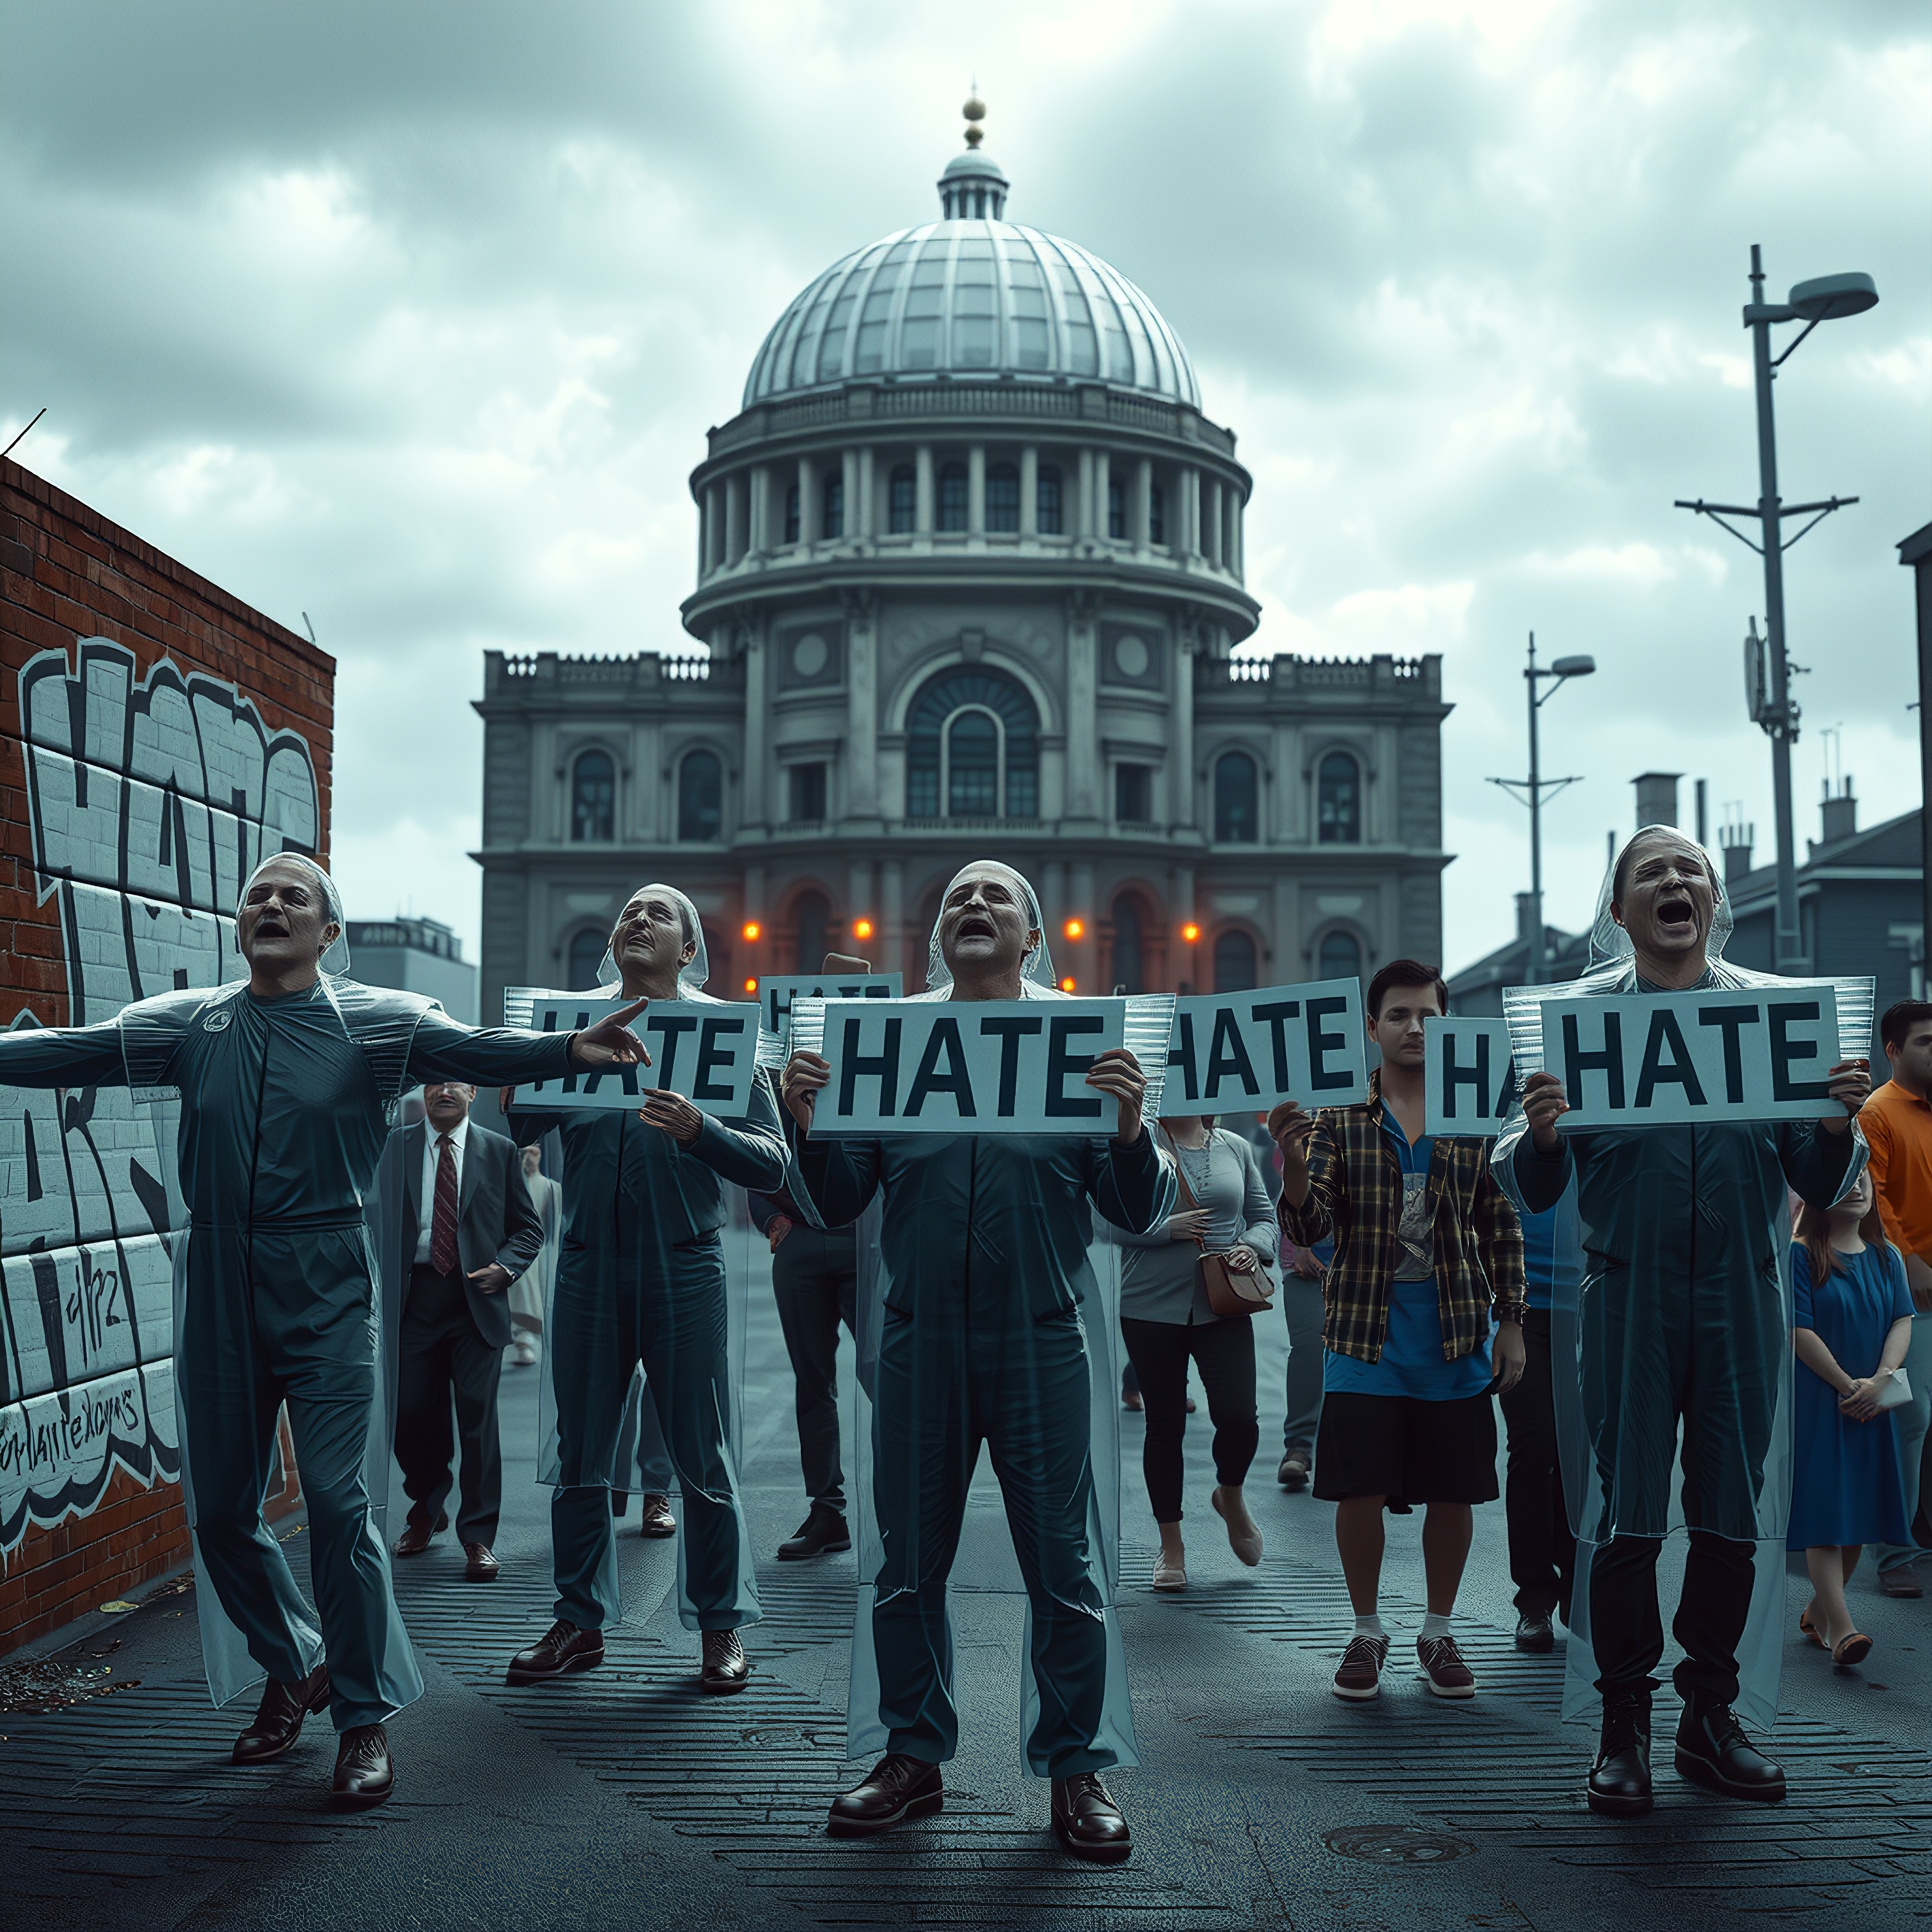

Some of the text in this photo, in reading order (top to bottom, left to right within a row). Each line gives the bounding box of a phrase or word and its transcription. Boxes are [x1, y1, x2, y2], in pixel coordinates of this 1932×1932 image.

[838, 1016, 1104, 1117] HATE
[1167, 996, 1354, 1102] HATE
[1561, 1001, 1831, 1111] HATE
